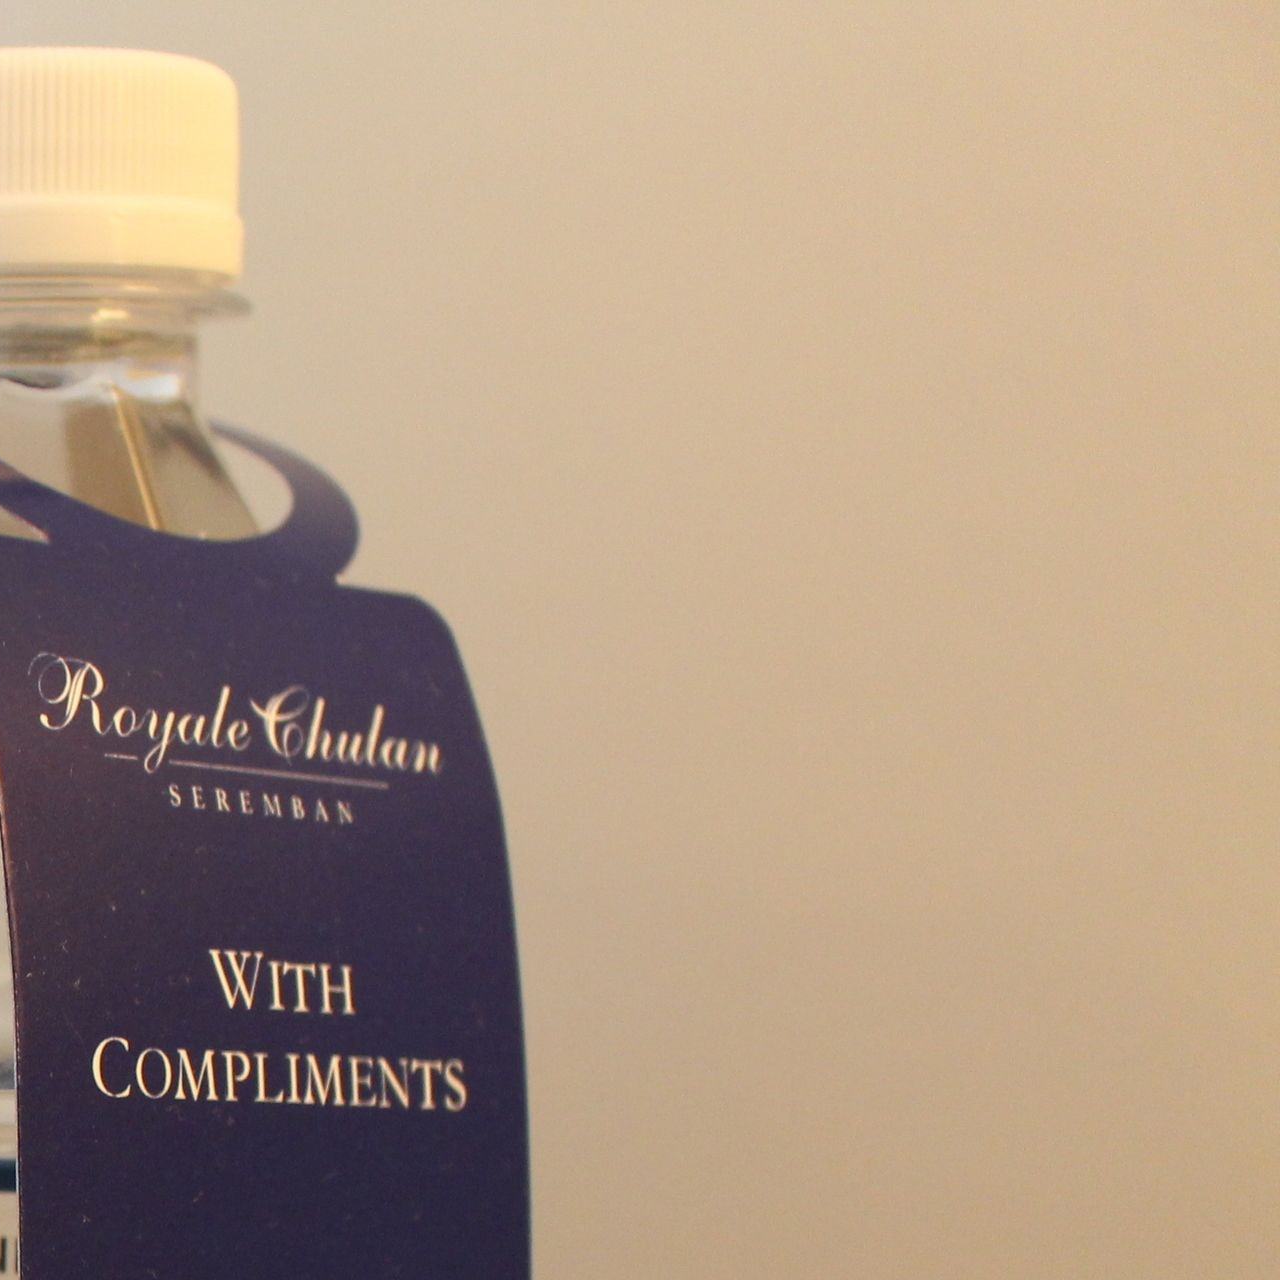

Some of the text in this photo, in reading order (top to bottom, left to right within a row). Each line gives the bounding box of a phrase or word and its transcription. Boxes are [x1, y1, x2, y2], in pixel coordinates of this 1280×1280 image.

[27, 652, 442, 775] Royale Chulan
[168, 784, 354, 825] SEREMBAN
